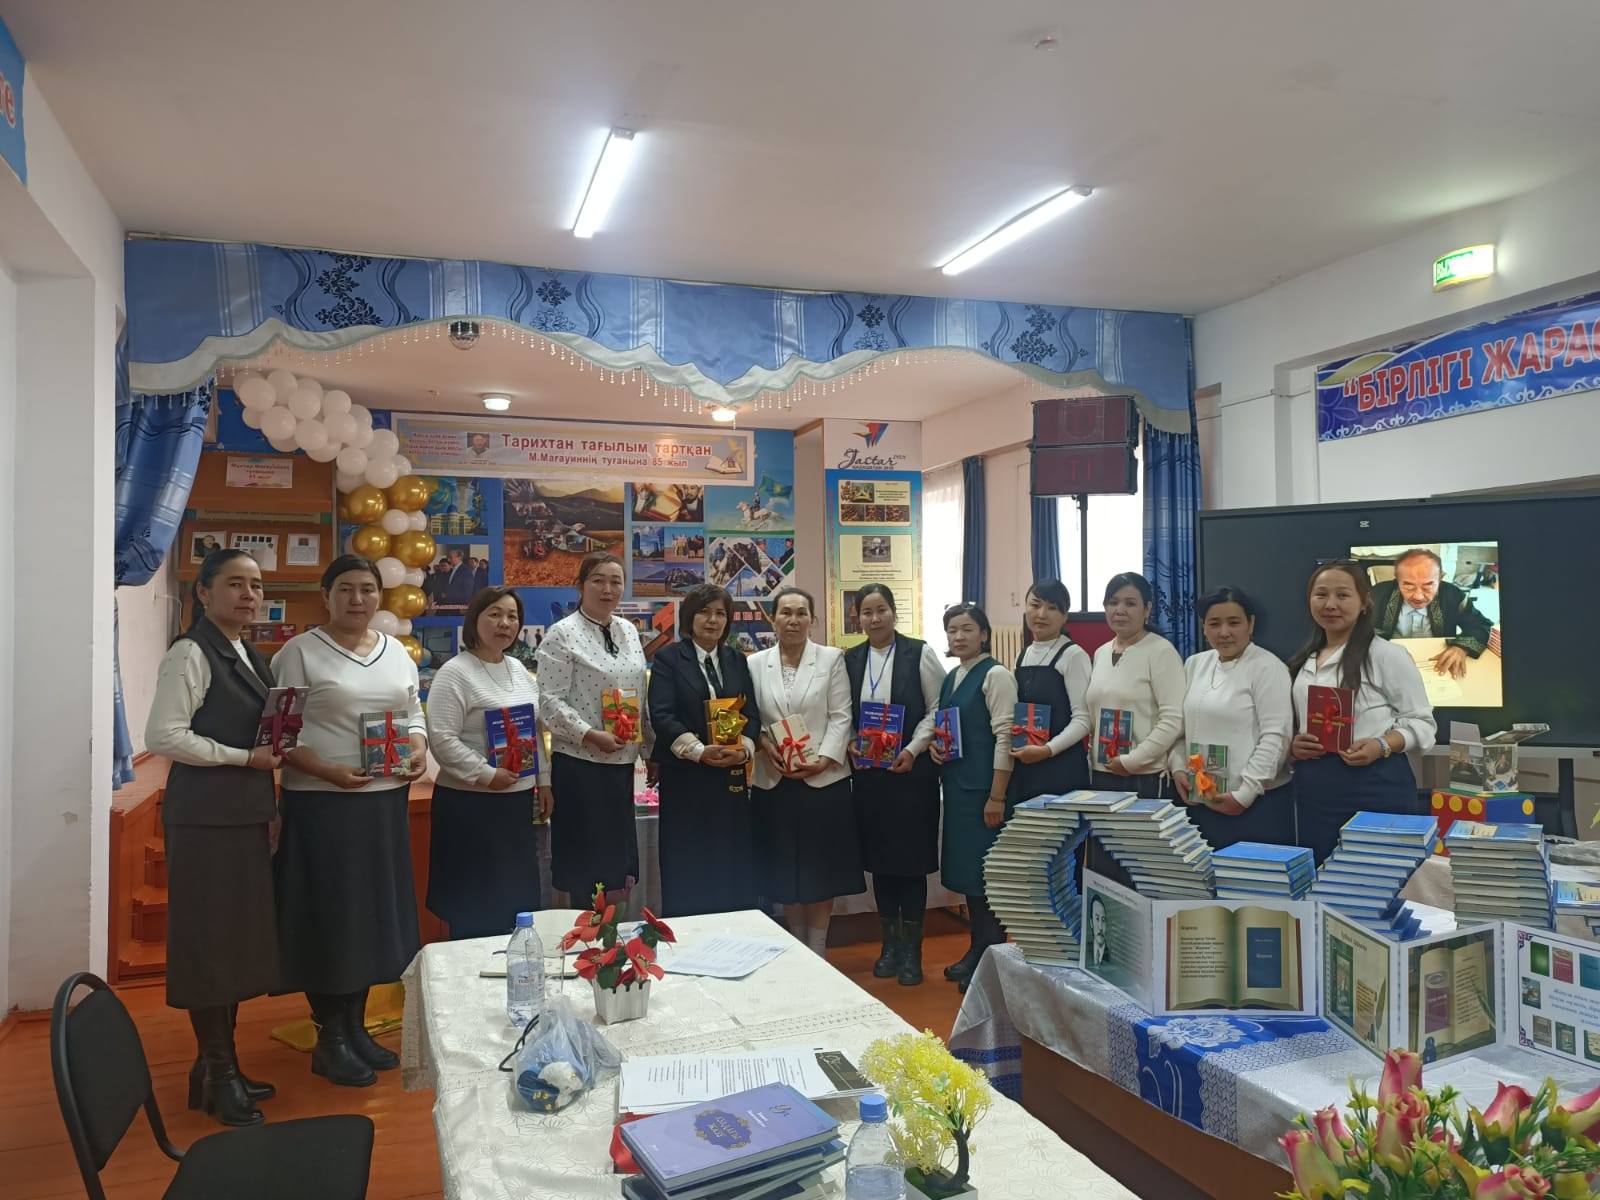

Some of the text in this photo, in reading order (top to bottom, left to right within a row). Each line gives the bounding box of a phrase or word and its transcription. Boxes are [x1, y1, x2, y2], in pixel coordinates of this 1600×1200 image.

[502, 433, 712, 457] Тарихтан тағылым тартқан
[652, 457, 663, 467] 85
[666, 460, 688, 468] жыл
